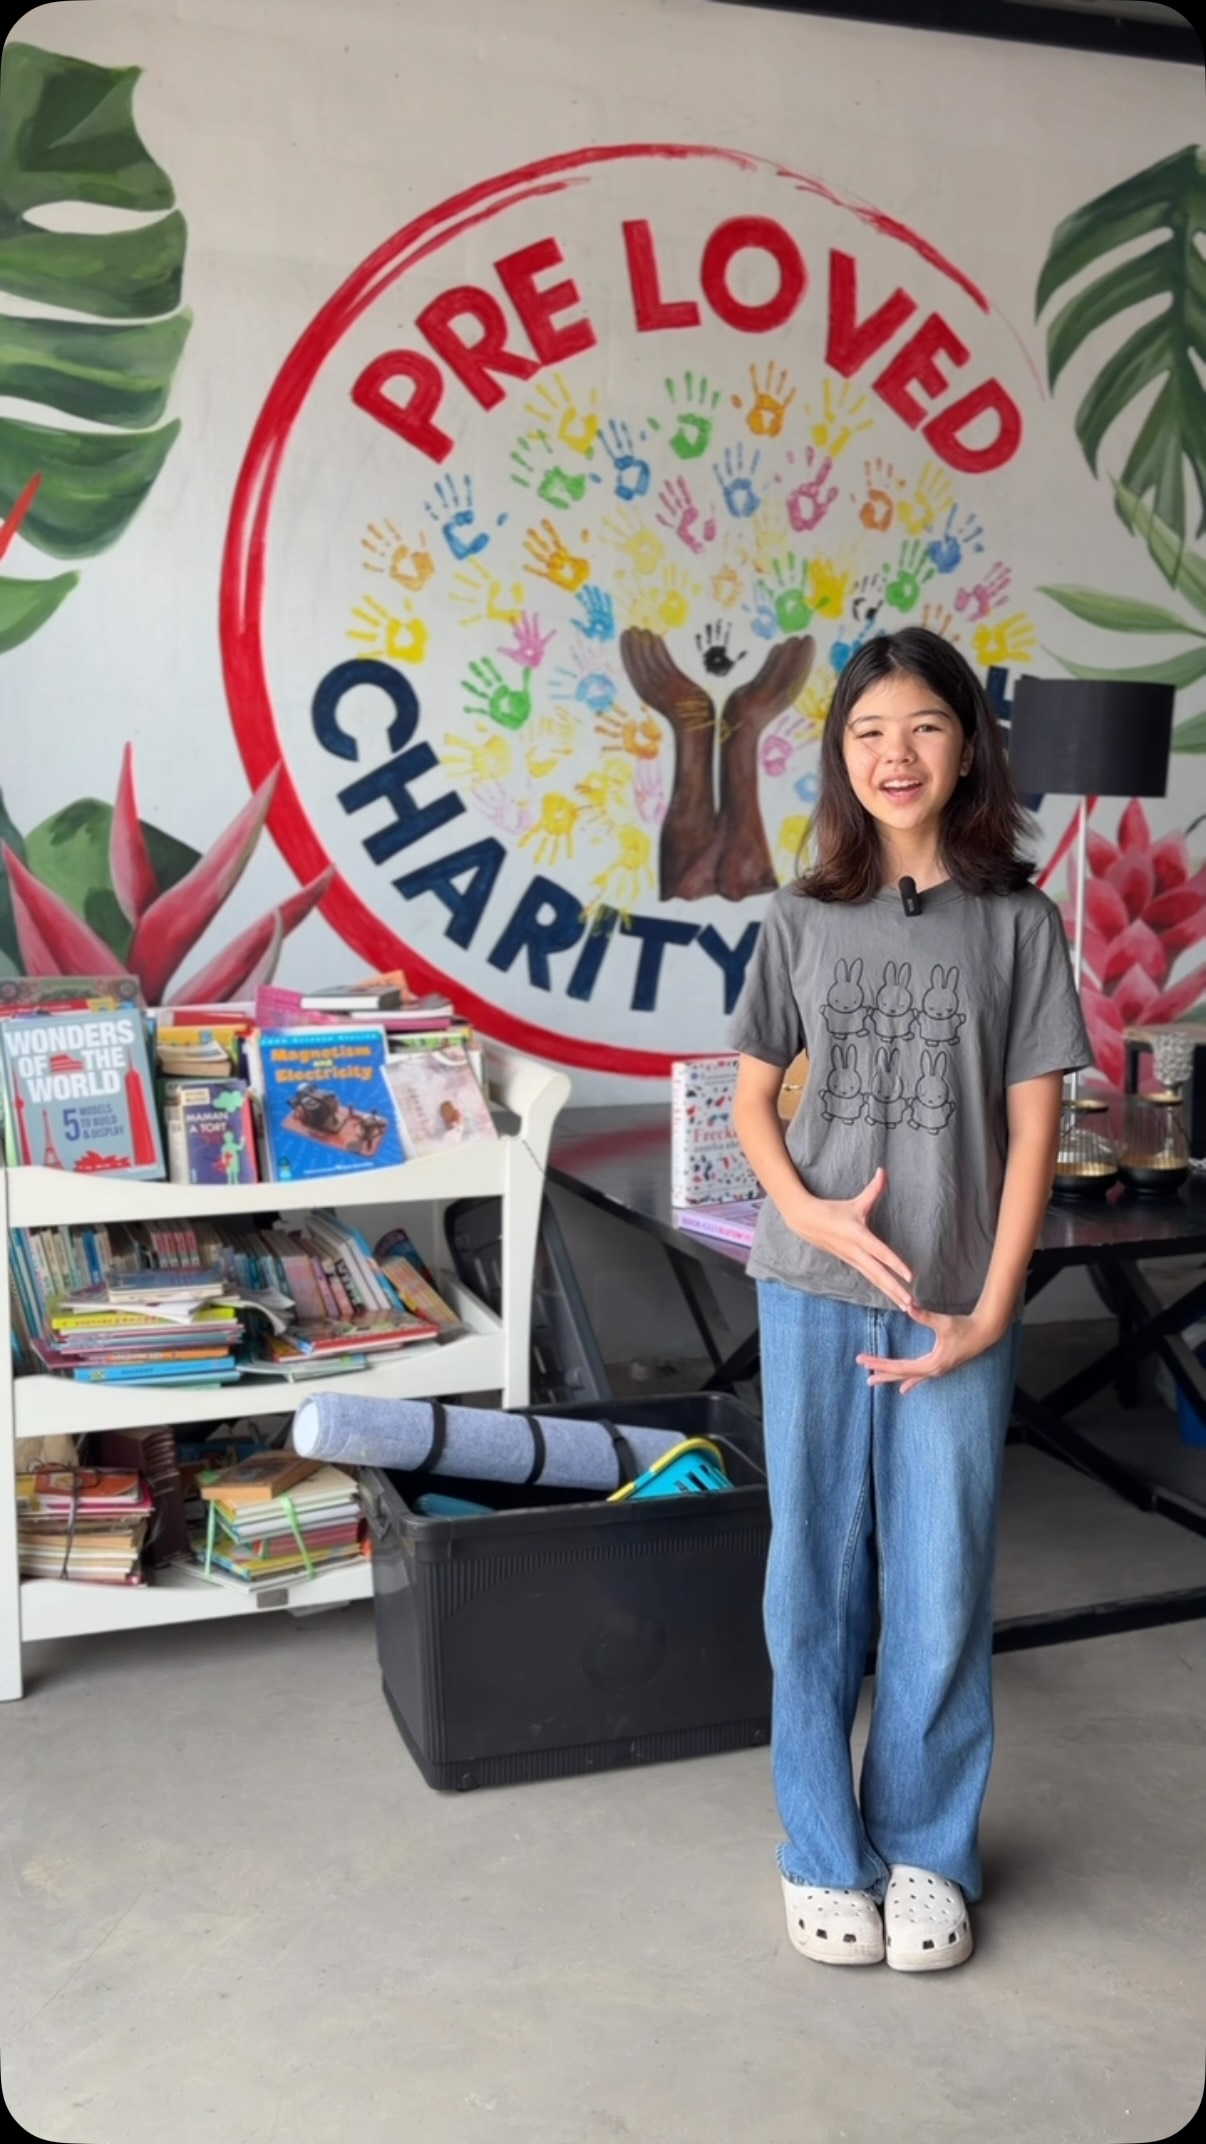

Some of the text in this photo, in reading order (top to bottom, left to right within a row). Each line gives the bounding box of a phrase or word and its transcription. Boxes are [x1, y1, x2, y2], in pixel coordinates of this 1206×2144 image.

[351, 215, 1022, 473] PRE LOVED
[311, 658, 762, 1015] CHARITY
[3, 1019, 135, 1057] WONDERS
[18, 1046, 126, 1078] OF THE
[271, 1045, 372, 1063] Magnetism
[275, 1064, 373, 1083] Electricity
[26, 1069, 121, 1103] WORLD
[79, 1104, 112, 1116] MODELS
[186, 1112, 229, 1122] MAMAN
[62, 1108, 81, 1141] 5
[80, 1114, 118, 1128] TO BUILD
[188, 1123, 199, 1133] A
[200, 1121, 228, 1133] TORT
[91, 1125, 124, 1138] DISPLAY
